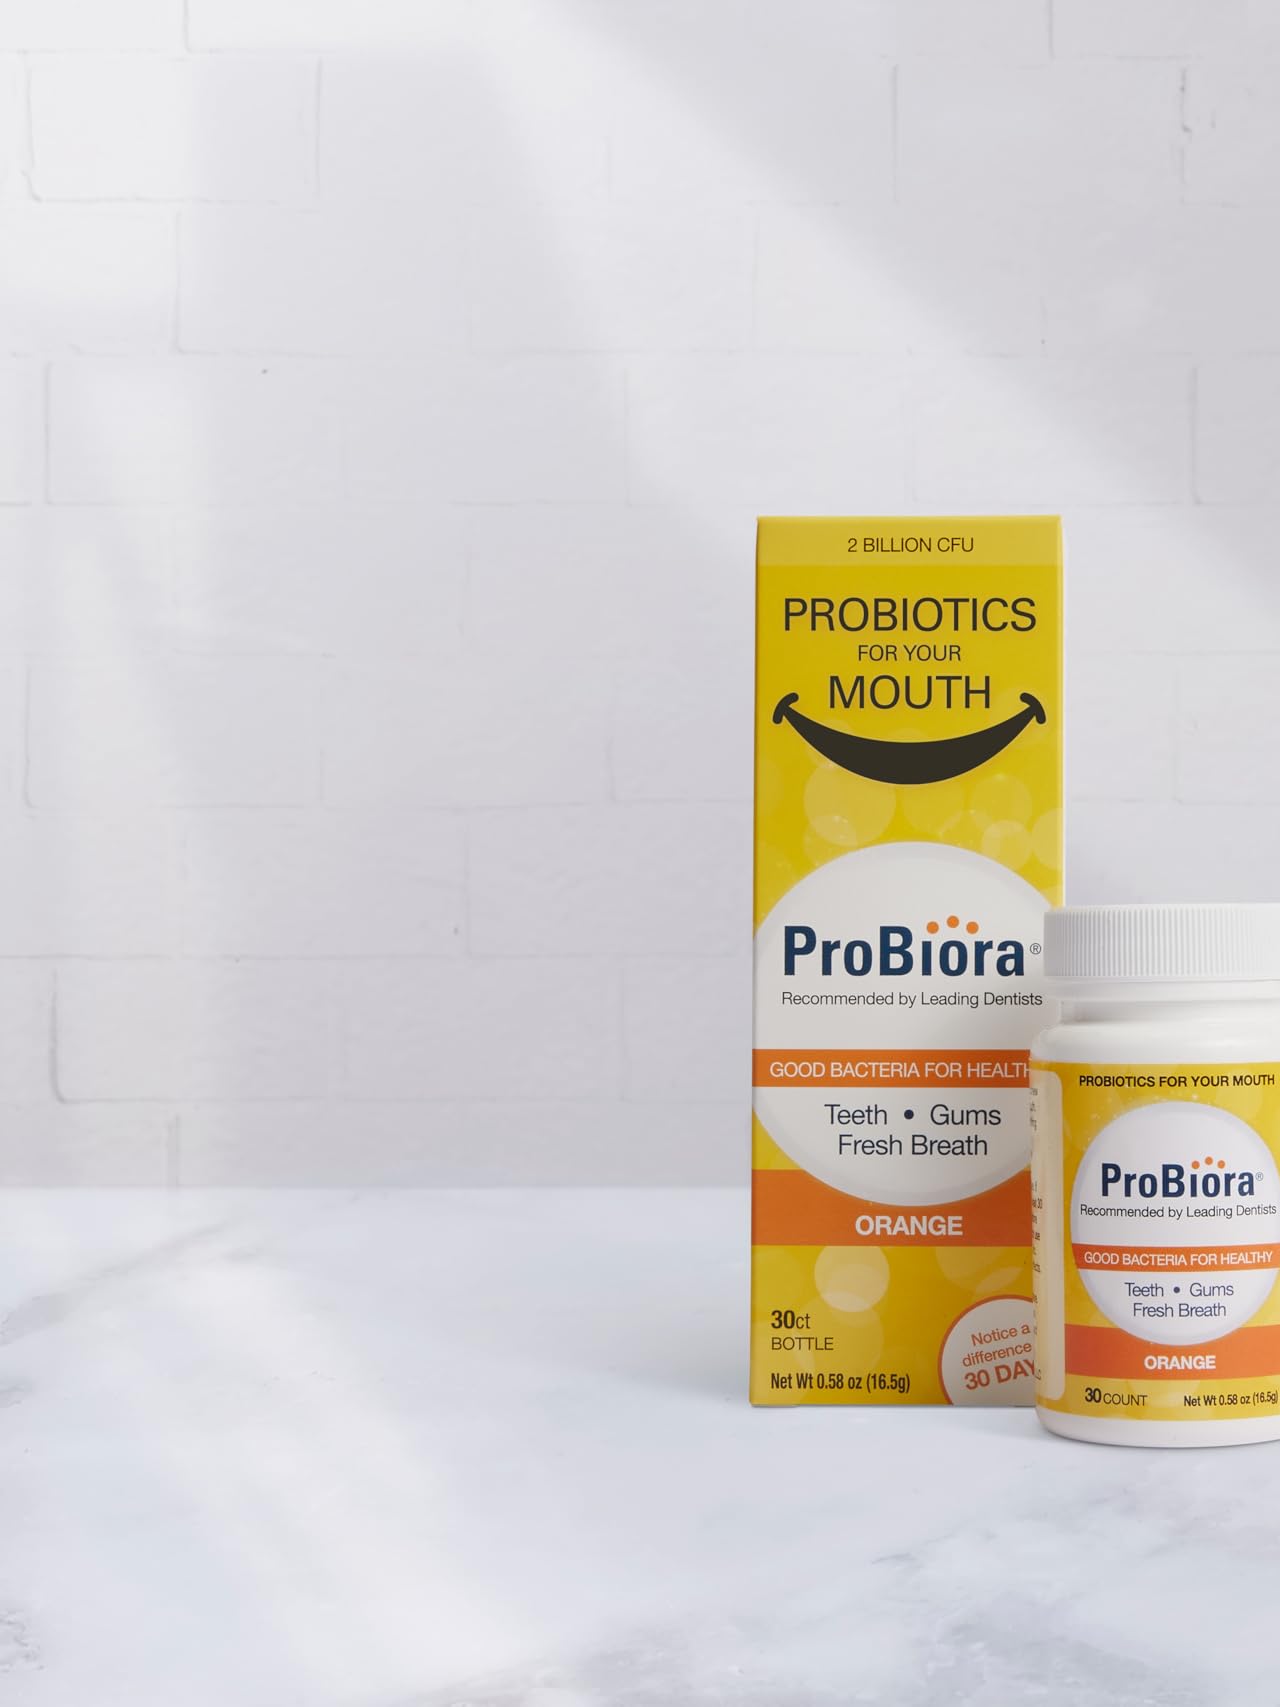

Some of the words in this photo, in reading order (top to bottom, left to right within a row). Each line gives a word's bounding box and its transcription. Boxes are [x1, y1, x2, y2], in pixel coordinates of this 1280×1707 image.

[847, 537, 858, 553] 2
[863, 537, 932, 553] BILLION
[936, 537, 975, 553] CFU
[783, 597, 1037, 632] PROBIOTICS
[857, 645, 898, 662] FOR
[903, 645, 962, 662] YOUR
[829, 674, 991, 710] MOUTH
[782, 991, 895, 1006] Recommended
[899, 991, 917, 1009] by
[921, 991, 979, 1009] Leading
[983, 991, 1043, 1006] Dentists
[769, 1062, 826, 1079] GOOD
[830, 1062, 921, 1079] BACTERIA
[925, 1062, 963, 1078] FOR
[967, 1062, 1030, 1078] HEALTH
[1079, 1075, 1156, 1088] PROBIOTICS
[1159, 1075, 1187, 1087] FOR
[1190, 1075, 1229, 1087] YOUR
[1232, 1074, 1275, 1086] MOUTH
[824, 1104, 889, 1126] Teeth
[929, 1104, 1002, 1126] Gums
[838, 1134, 903, 1156] Fresh
[911, 1134, 988, 1156] Breath
[1080, 1204, 1165, 1218] Recommended
[1168, 1205, 1183, 1220] by
[1186, 1204, 1233, 1220] Leading
[1236, 1203, 1277, 1216] Dentists
[855, 1215, 963, 1236] ORANGE
[1084, 1251, 1119, 1265] GOOD
[1122, 1252, 1187, 1267] BACTERIA
[1190, 1252, 1218, 1266] FOR
[1220, 1250, 1273, 1264] HEALTHY
[1124, 1282, 1164, 1297] Teeth
[1189, 1282, 1234, 1297] Gums
[1133, 1302, 1174, 1318] Fresh
[1178, 1302, 1227, 1318] Breath
[771, 1337, 834, 1351] BOTTLE
[970, 1328, 1018, 1347] Notice
[1021, 1324, 1031, 1335] a
[962, 1342, 1032, 1367] difference
[1144, 1355, 1216, 1371] ORANGE
[771, 1373, 792, 1390] Net
[796, 1373, 813, 1390] Wt
[816, 1373, 844, 1390] 0.58
[847, 1377, 863, 1390] oz
[866, 1373, 911, 1393] (16.5g)
[964, 1369, 990, 1390] 30
[994, 1359, 1035, 1384] DAY
[1183, 1395, 1200, 1407] Net
[1203, 1394, 1217, 1406] Wt
[1218, 1392, 1238, 1405] 0.58
[1240, 1394, 1251, 1405] oz
[1252, 1391, 1279, 1405] (16.5g)
